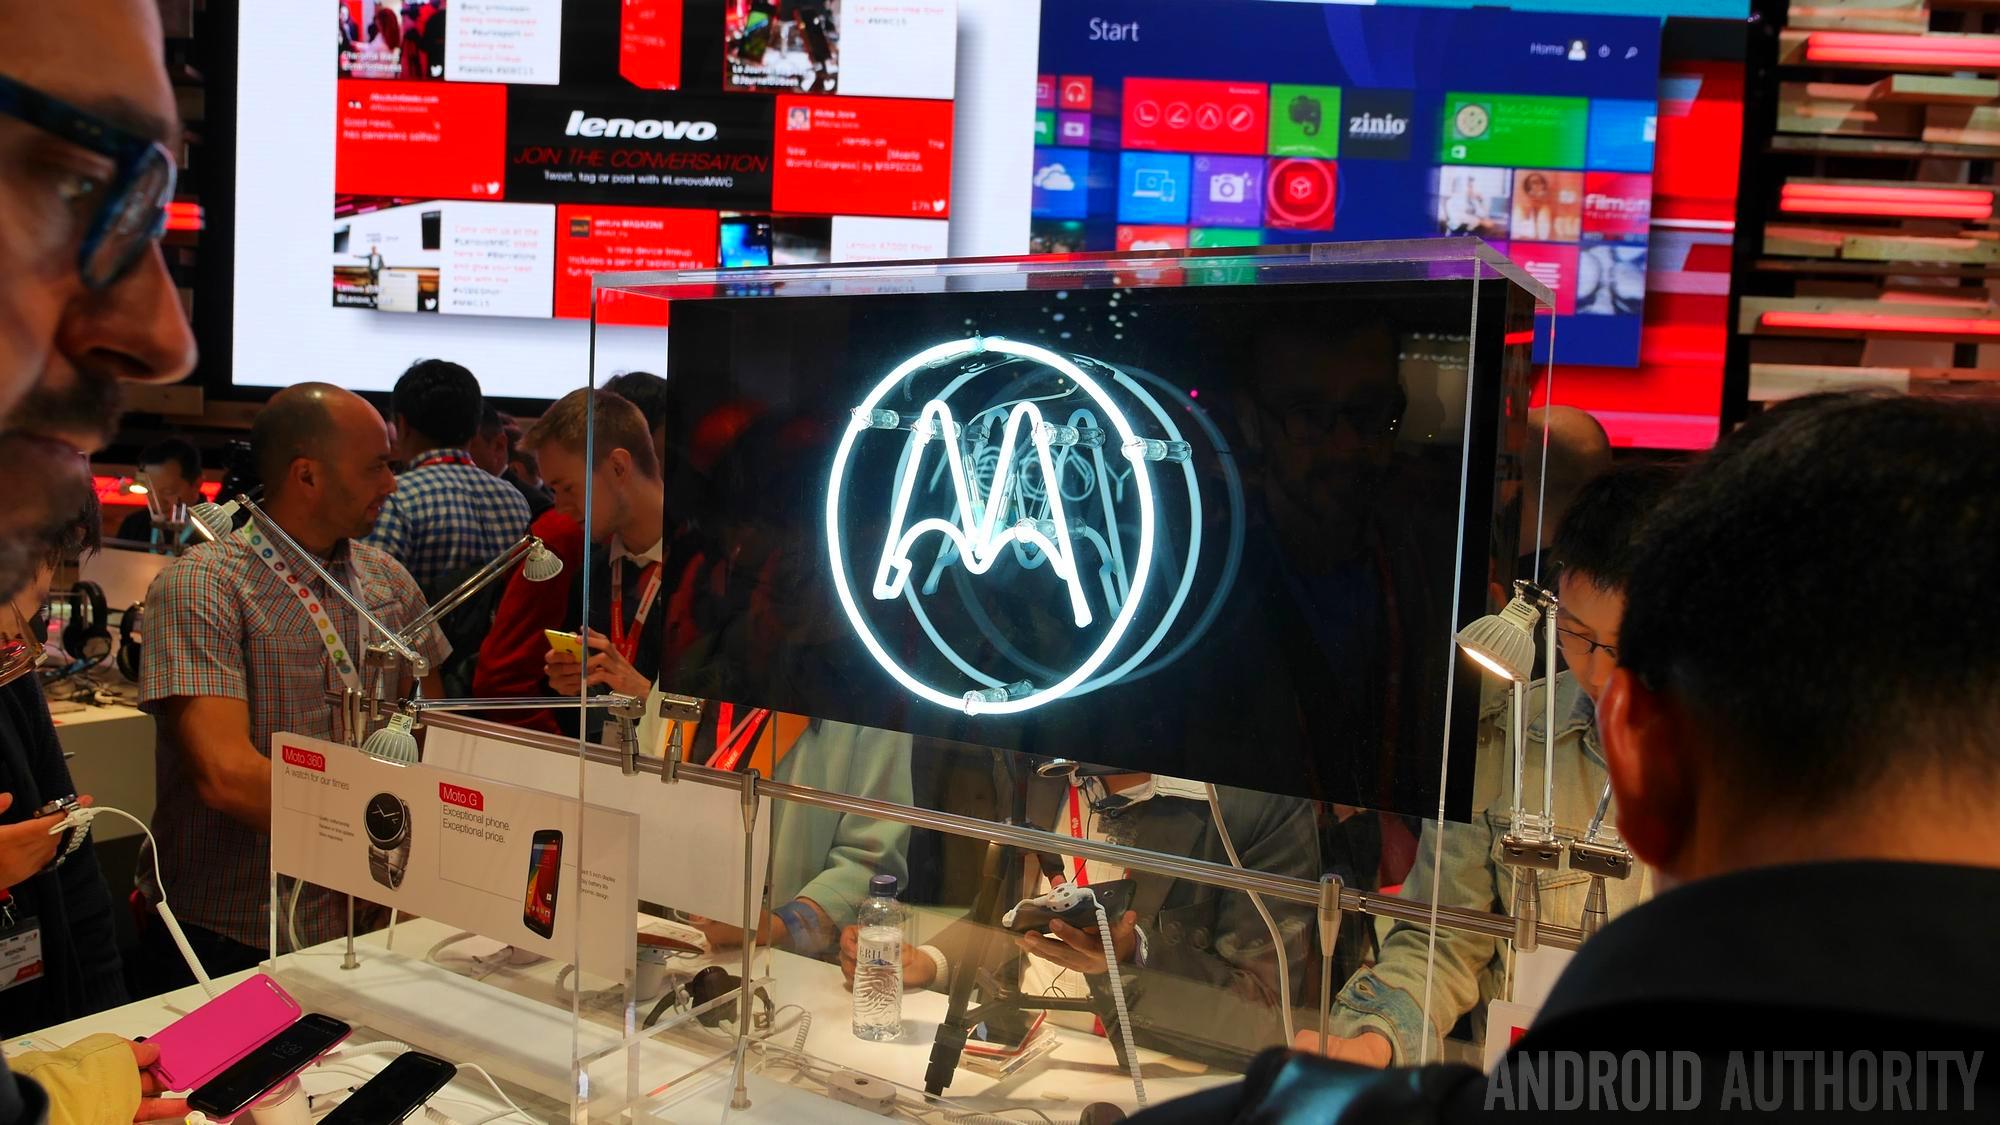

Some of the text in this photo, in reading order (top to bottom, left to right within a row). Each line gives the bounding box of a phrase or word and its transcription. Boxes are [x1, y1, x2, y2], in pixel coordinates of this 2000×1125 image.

[1089, 17, 1140, 42] Start
[1530, 42, 1565, 55] Home
[565, 110, 717, 142] lenovo
[1349, 113, 1408, 135] zinio
[513, 146, 769, 173] JOIN THE CONVERSATION
[544, 169, 733, 188] Tweet, tag or post with #LenovoMWC
[284, 748, 323, 769] Moto 360
[285, 767, 350, 791] A watch for our times
[443, 786, 478, 806] Moto G
[443, 804, 511, 832] Exceptional phone.
[443, 818, 506, 845] Exceptional price.
